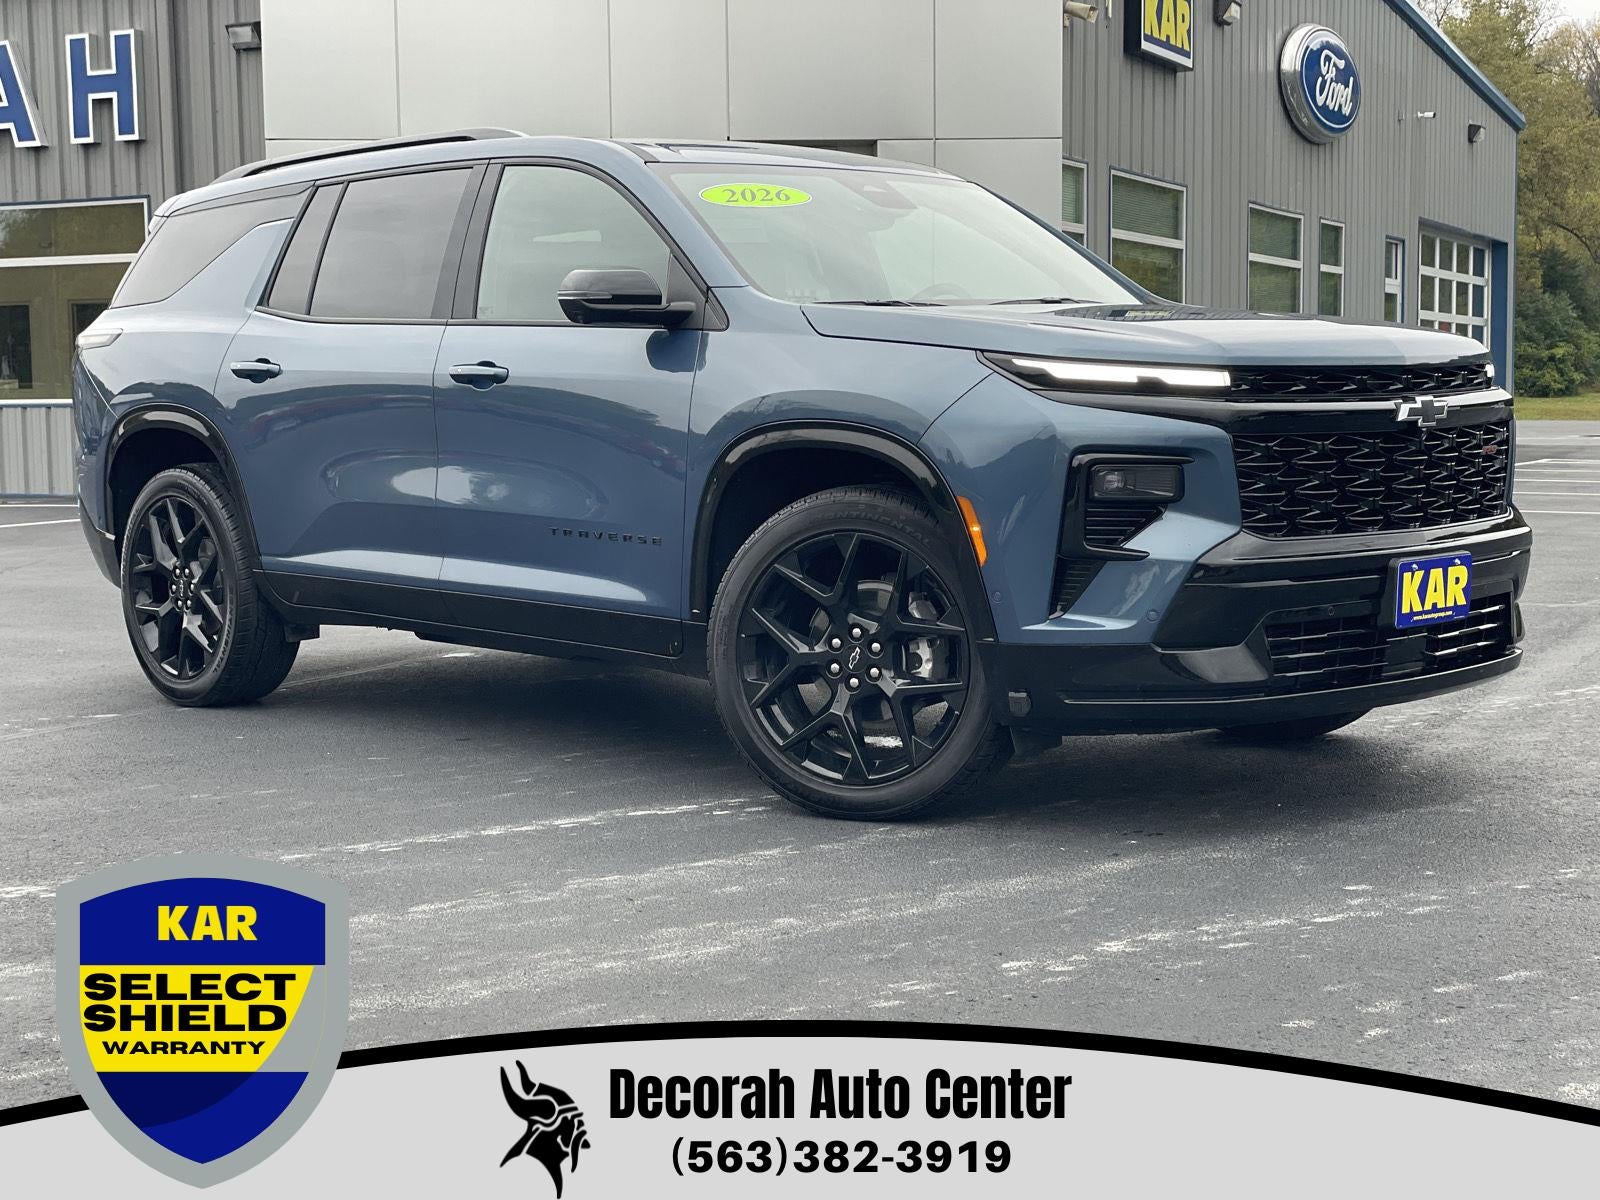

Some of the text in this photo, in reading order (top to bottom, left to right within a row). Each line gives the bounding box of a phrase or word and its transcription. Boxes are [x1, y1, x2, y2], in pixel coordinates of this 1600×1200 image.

[1144, 0, 1190, 51] KAR
[1316, 49, 1354, 116] Ford
[721, 188, 791, 203] 2026
[548, 526, 663, 546] TRAVERSE
[1401, 565, 1469, 614] KAR
